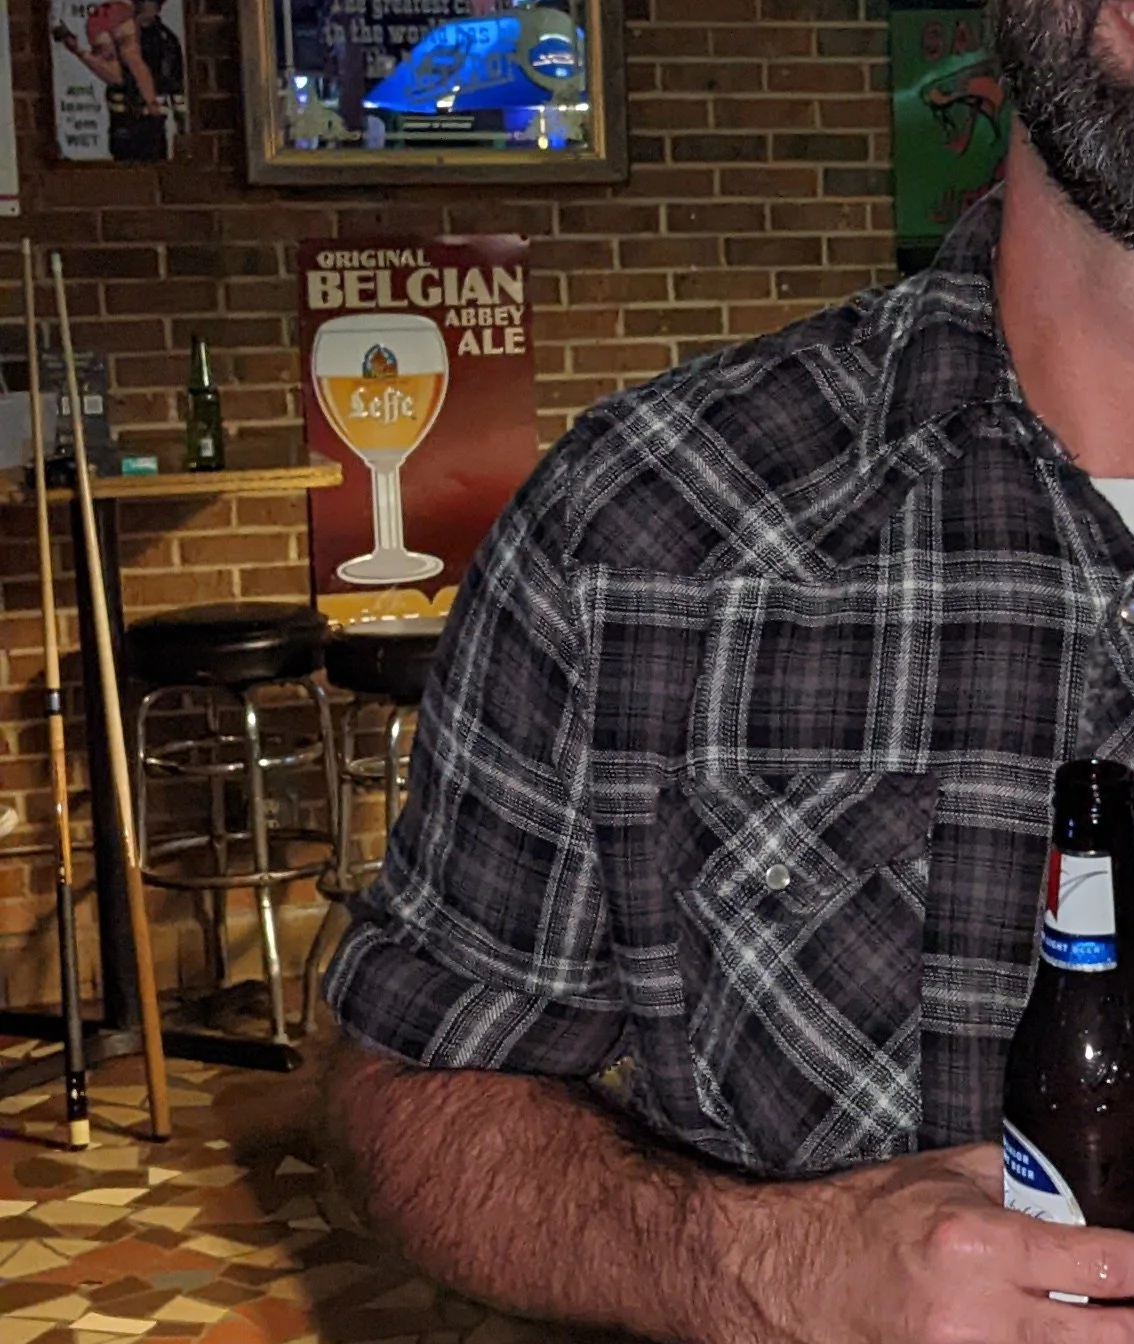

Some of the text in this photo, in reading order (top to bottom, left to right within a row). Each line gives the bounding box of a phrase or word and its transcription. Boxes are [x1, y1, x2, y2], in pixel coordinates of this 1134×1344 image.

[350, 18, 385, 45] the
[316, 249, 431, 269] ORIGINAL
[305, 265, 526, 311] BELGIAN
[445, 305, 525, 328] ABBEY
[457, 327, 526, 357] ALE
[349, 385, 417, 424] Leffe
[1010, 1160, 1035, 1181] BEER
